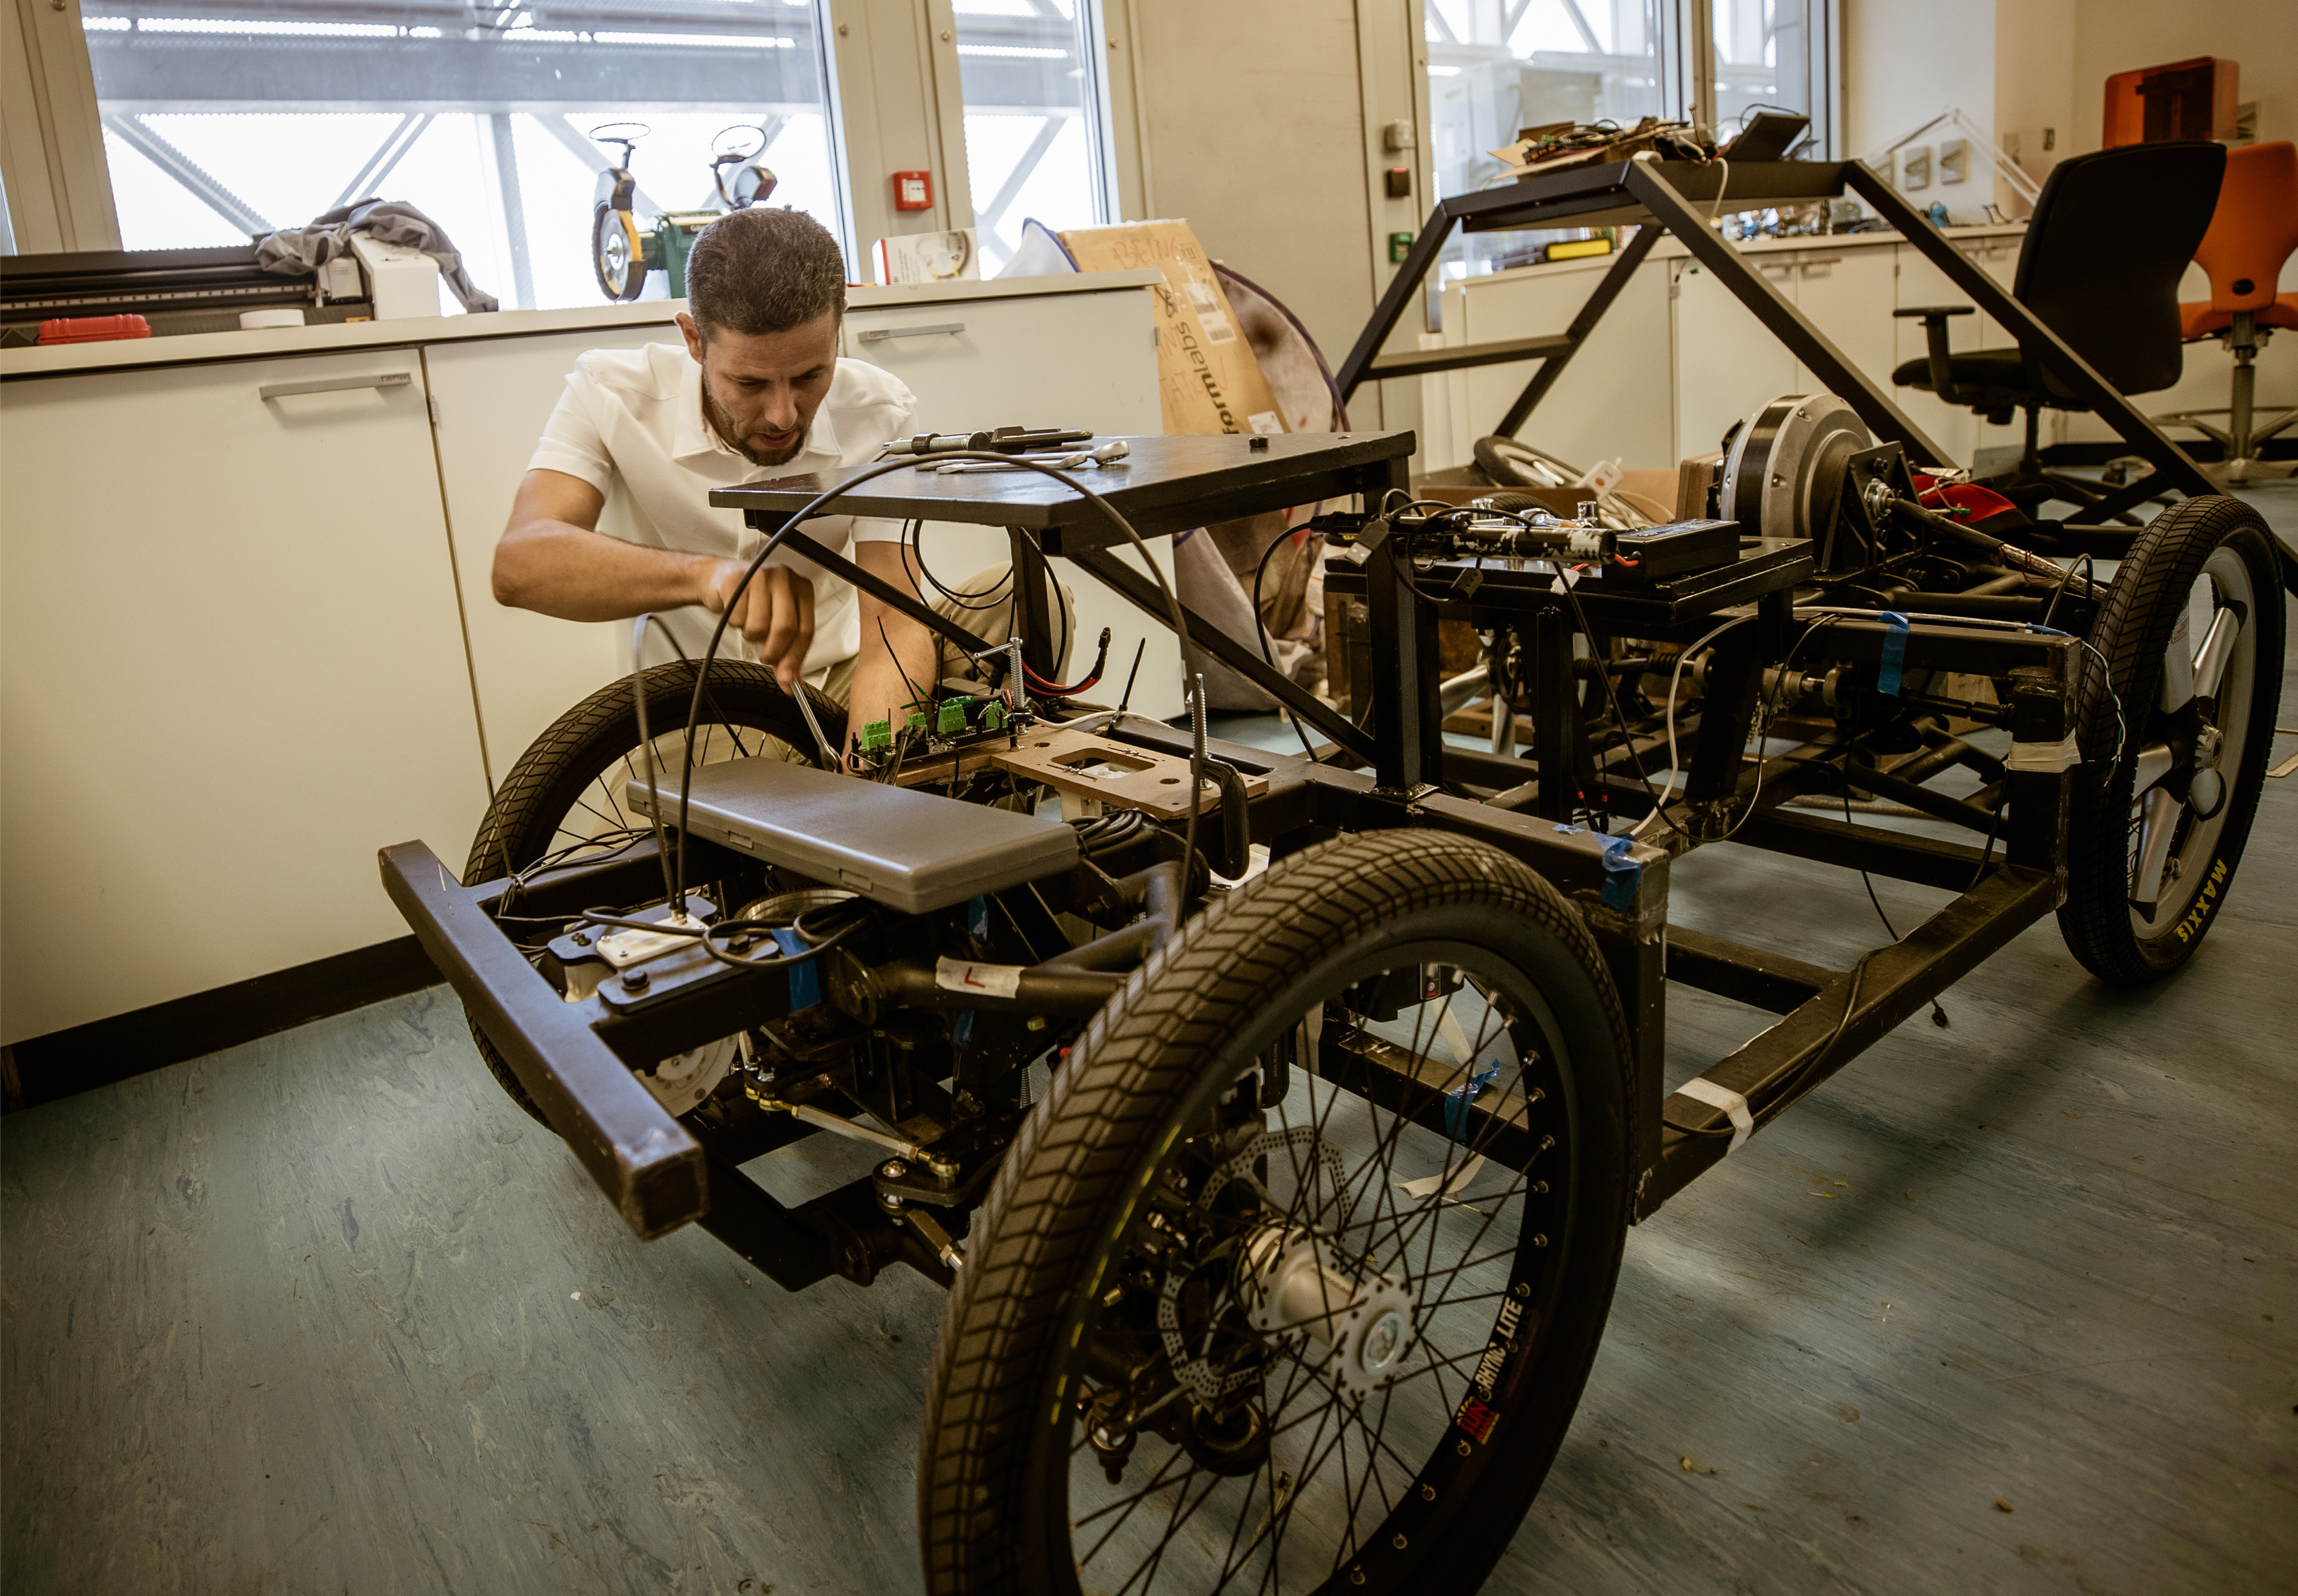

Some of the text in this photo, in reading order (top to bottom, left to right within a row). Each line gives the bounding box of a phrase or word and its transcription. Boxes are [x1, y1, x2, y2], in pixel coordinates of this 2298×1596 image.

[2177, 858, 2227, 942] MAXXIS
[964, 967, 985, 988] L
[1496, 1297, 1523, 1339] LITE
